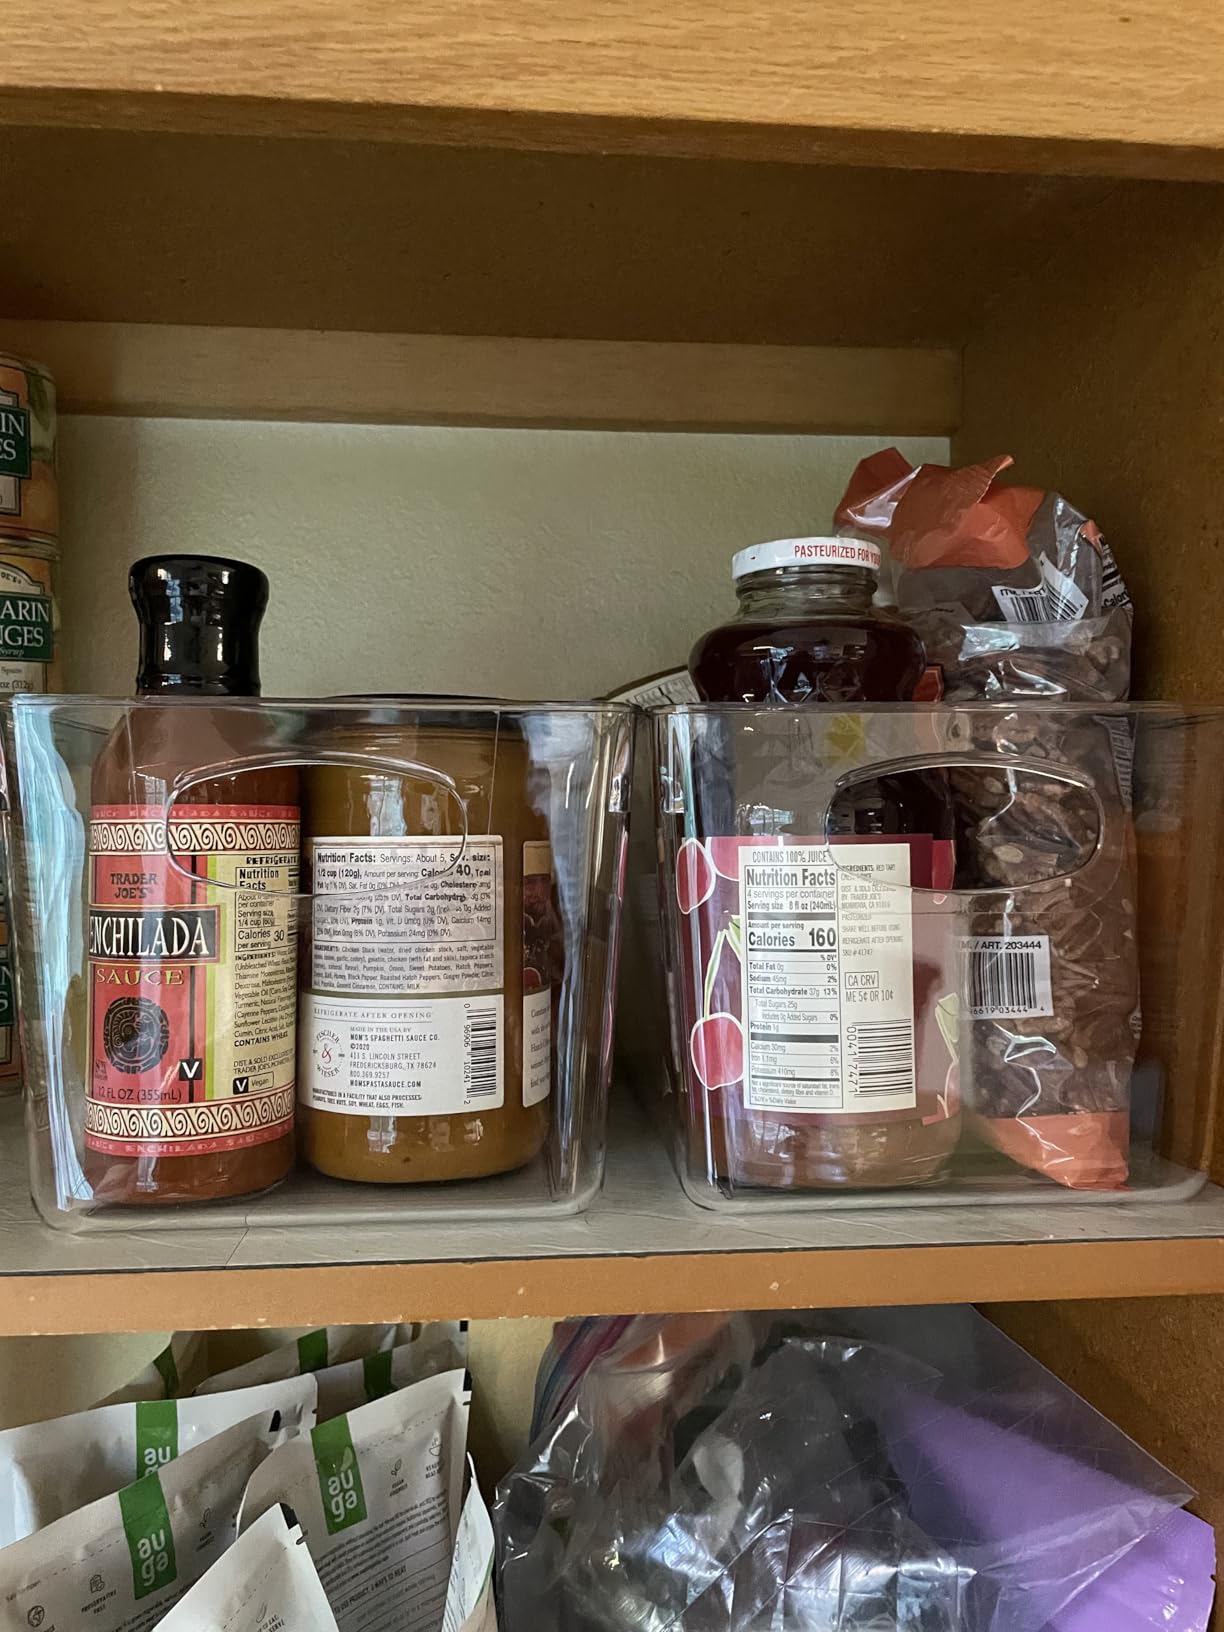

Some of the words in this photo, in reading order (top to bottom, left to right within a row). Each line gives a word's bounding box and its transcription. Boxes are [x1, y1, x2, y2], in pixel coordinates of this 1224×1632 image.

[795, 545, 855, 559] PASTEURIZED
[858, 549, 869, 561] FOR
[317, 853, 346, 863] Nutrition
[350, 853, 376, 862] Facts:
[380, 854, 413, 864] Servings:
[416, 853, 436, 862] About
[440, 854, 446, 864] 5,
[753, 851, 783, 863] CONTAINS
[786, 851, 805, 862] 100%
[807, 851, 827, 862] JUICE
[111, 873, 157, 886] TRADER
[240, 869, 279, 879] Nutrition
[327, 871, 337, 880] cup
[339, 869, 362, 879] (120g),
[747, 869, 797, 886] Nutrition
[802, 868, 835, 886] Facts
[240, 880, 266, 890] Facts
[753, 890, 784, 899] servings
[786, 891, 798, 899] per
[800, 890, 834, 898] container
[340, 905, 351, 913] Fiber
[405, 905, 424, 914] Sugars
[474, 903, 491, 911] Added
[748, 902, 769, 911] Serving
[772, 902, 783, 910] size
[810, 901, 835, 911] (240mL)
[238, 919, 248, 927] 1/4
[250, 919, 261, 927] cup
[783, 922, 804, 930] serving
[90, 917, 209, 956] ENCHILADA
[238, 930, 271, 939] Calories
[274, 930, 284, 941] 30
[749, 932, 795, 946] Calories
[809, 928, 836, 946] 160
[250, 941, 271, 949] serving
[1005, 940, 1042, 949] 203444
[777, 963, 784, 972] 0g
[96, 968, 184, 986] SAUCE
[772, 975, 787, 984] 45mg
[847, 975, 858, 987] CA
[860, 975, 875, 986] CRV
[766, 988, 808, 996] Carbohydrate
[809, 988, 820, 997] 37g
[824, 988, 837, 996] 13%
[846, 992, 857, 1002] ME
[870, 990, 879, 1001] OR
[881, 990, 894, 1001] 10¢
[755, 999, 767, 1007] Total
[768, 1000, 786, 1009] Sugars
[787, 1000, 798, 1009] 25g
[314, 1009, 357, 1018] REFRIGERATE
[998, 1006, 1028, 1014] 03444
[787, 1013, 801, 1021] Added
[802, 1013, 817, 1022] Sugars
[750, 1023, 772, 1031] Protein
[772, 1024, 779, 1033] 1g
[234, 1035, 270, 1047] CONTAINS
[847, 1026, 857, 1057] 0041
[751, 1042, 771, 1050] Calcium
[771, 1043, 786, 1052] 30mg
[181, 1062, 199, 1078] V
[350, 1062, 404, 1070] FREDERICKSBURG,
[752, 1066, 776, 1074] Potassium
[778, 1067, 795, 1076] 410mg
[252, 1077, 269, 1087] Vegan
[848, 1063, 857, 1093] 7471
[236, 1079, 247, 1092] V
[350, 1080, 422, 1088] MOMSPASTASAUCE.COM
[107, 1087, 118, 1098] FL
[120, 1088, 134, 1099] OZ
[137, 1088, 182, 1101] (355mL)
[144, 1446, 171, 1465] au
[328, 1469, 354, 1496] au
[331, 1491, 358, 1522] ga
[137, 1529, 166, 1559] au
[141, 1551, 168, 1586] ga
